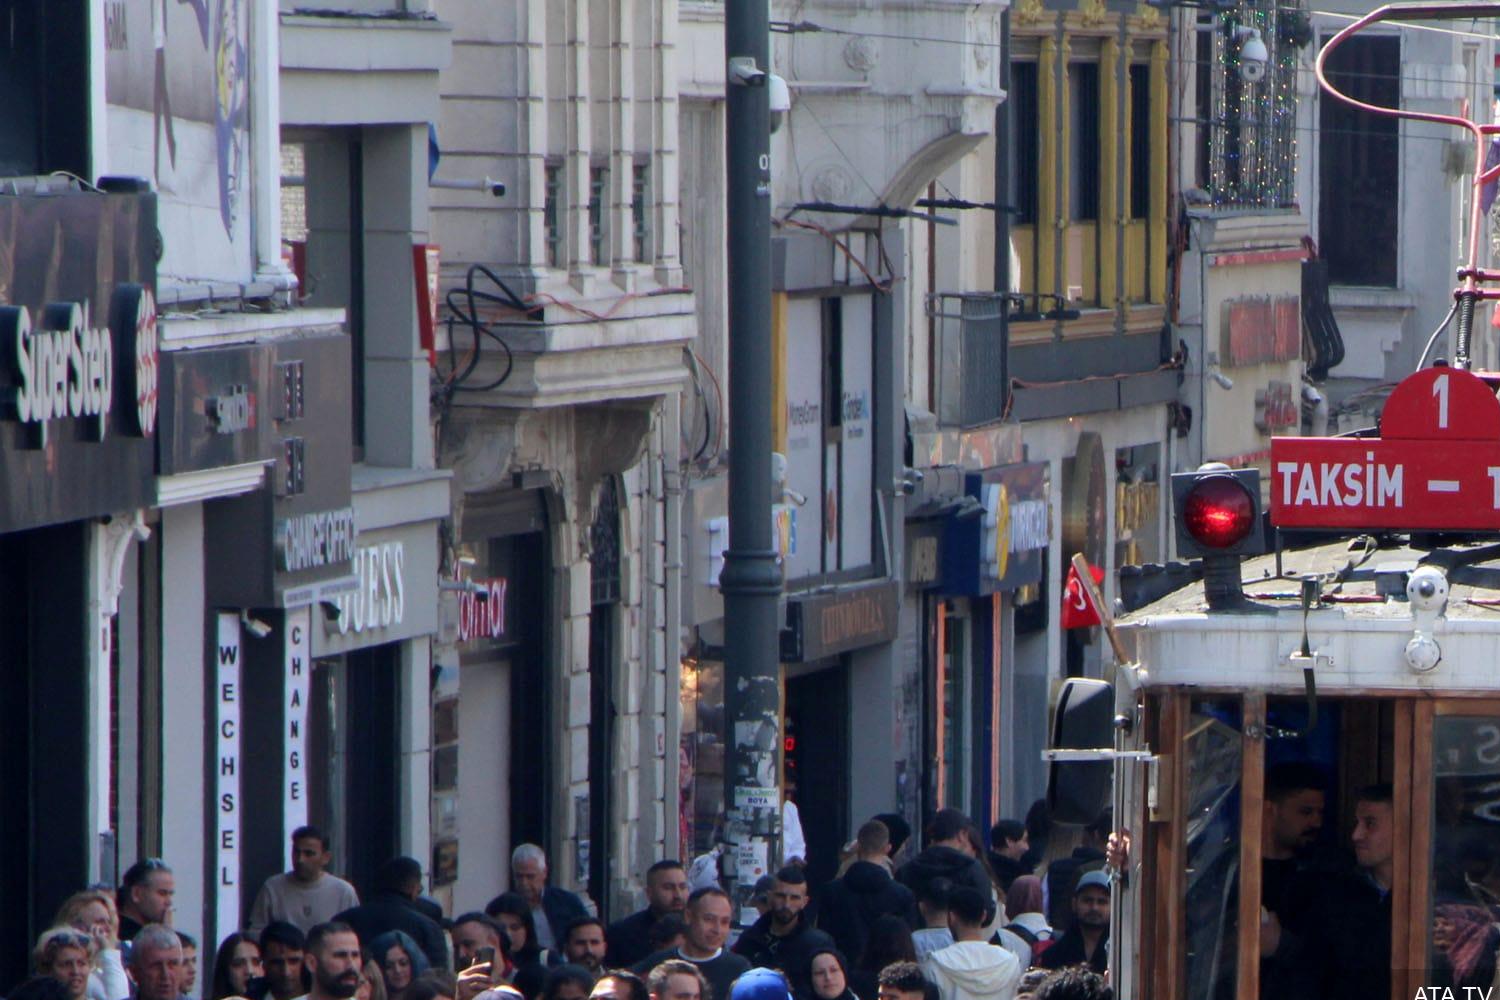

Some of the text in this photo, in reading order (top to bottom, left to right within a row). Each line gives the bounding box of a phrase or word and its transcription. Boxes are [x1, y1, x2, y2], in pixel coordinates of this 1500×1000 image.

[17, 298, 112, 449] SuperStep
[1431, 374, 1450, 429] 1
[1277, 451, 1403, 507] TAKSİM
[285, 512, 325, 572] CHANGE
[290, 626, 301, 800] CHANGE
[219, 646, 238, 886] WECHSEL
